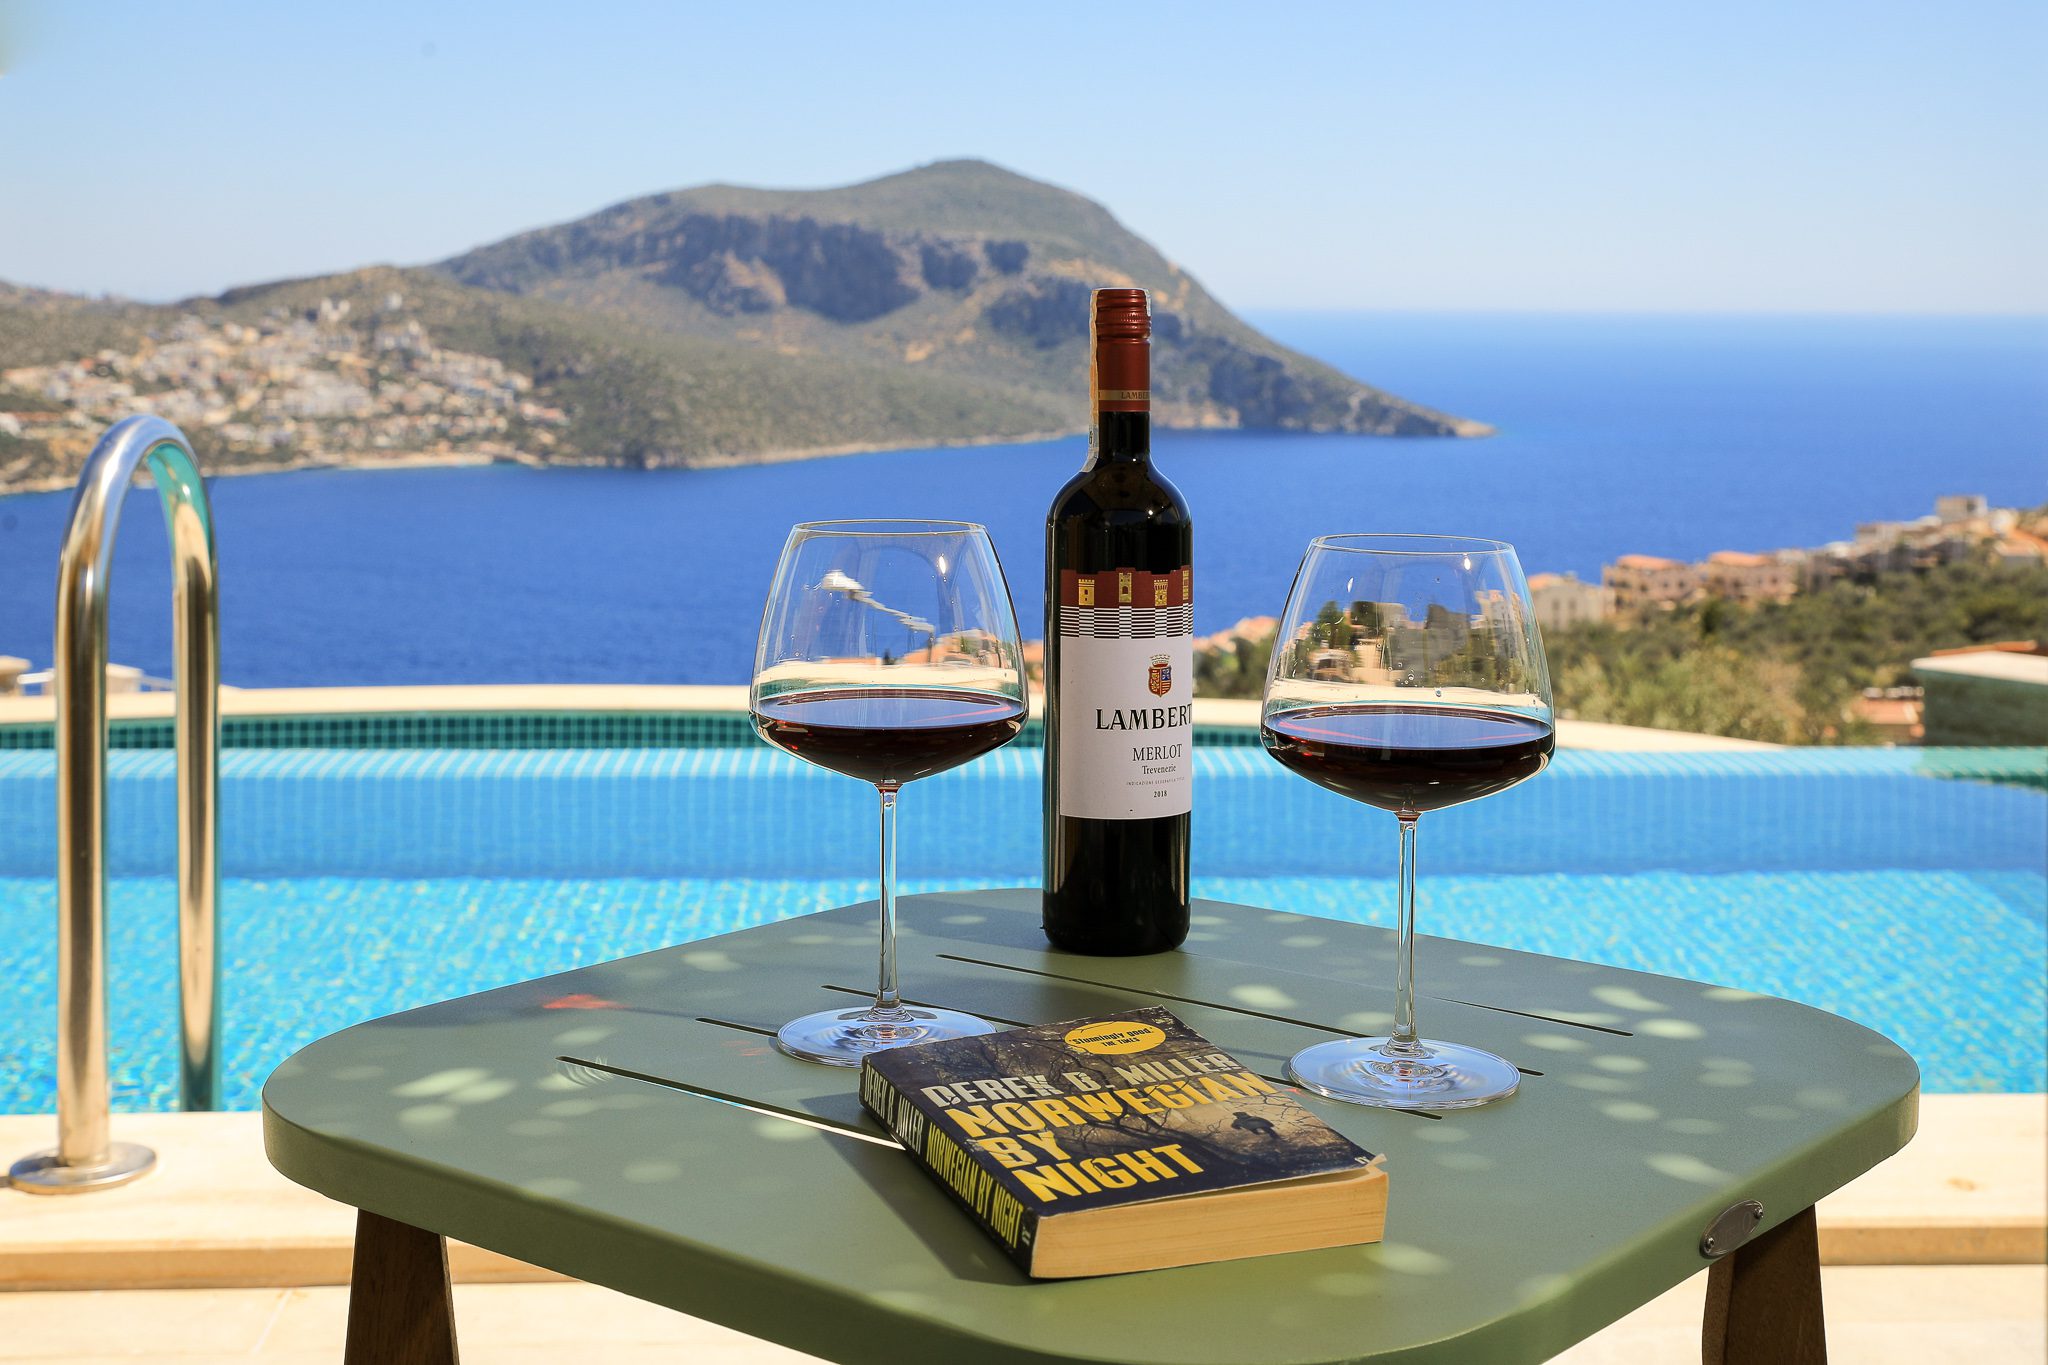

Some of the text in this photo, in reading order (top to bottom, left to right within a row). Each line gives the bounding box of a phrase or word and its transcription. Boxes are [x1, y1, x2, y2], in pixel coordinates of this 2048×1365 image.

[1132, 743, 1182, 761] MERLOT
[1141, 763, 1176, 775] Trevenezie
[1153, 789, 1168, 798] 2018
[1117, 1037, 1141, 1045] TIMES
[920, 1053, 1242, 1108] DEREK B. MILLER
[944, 1072, 1279, 1138] NORWEGIAN
[864, 1064, 1024, 1249] DEREK B. MILLER NORWEGIAN BY NIGHT
[977, 1130, 1073, 1169] BY
[1011, 1144, 1205, 1203] NIGHT
